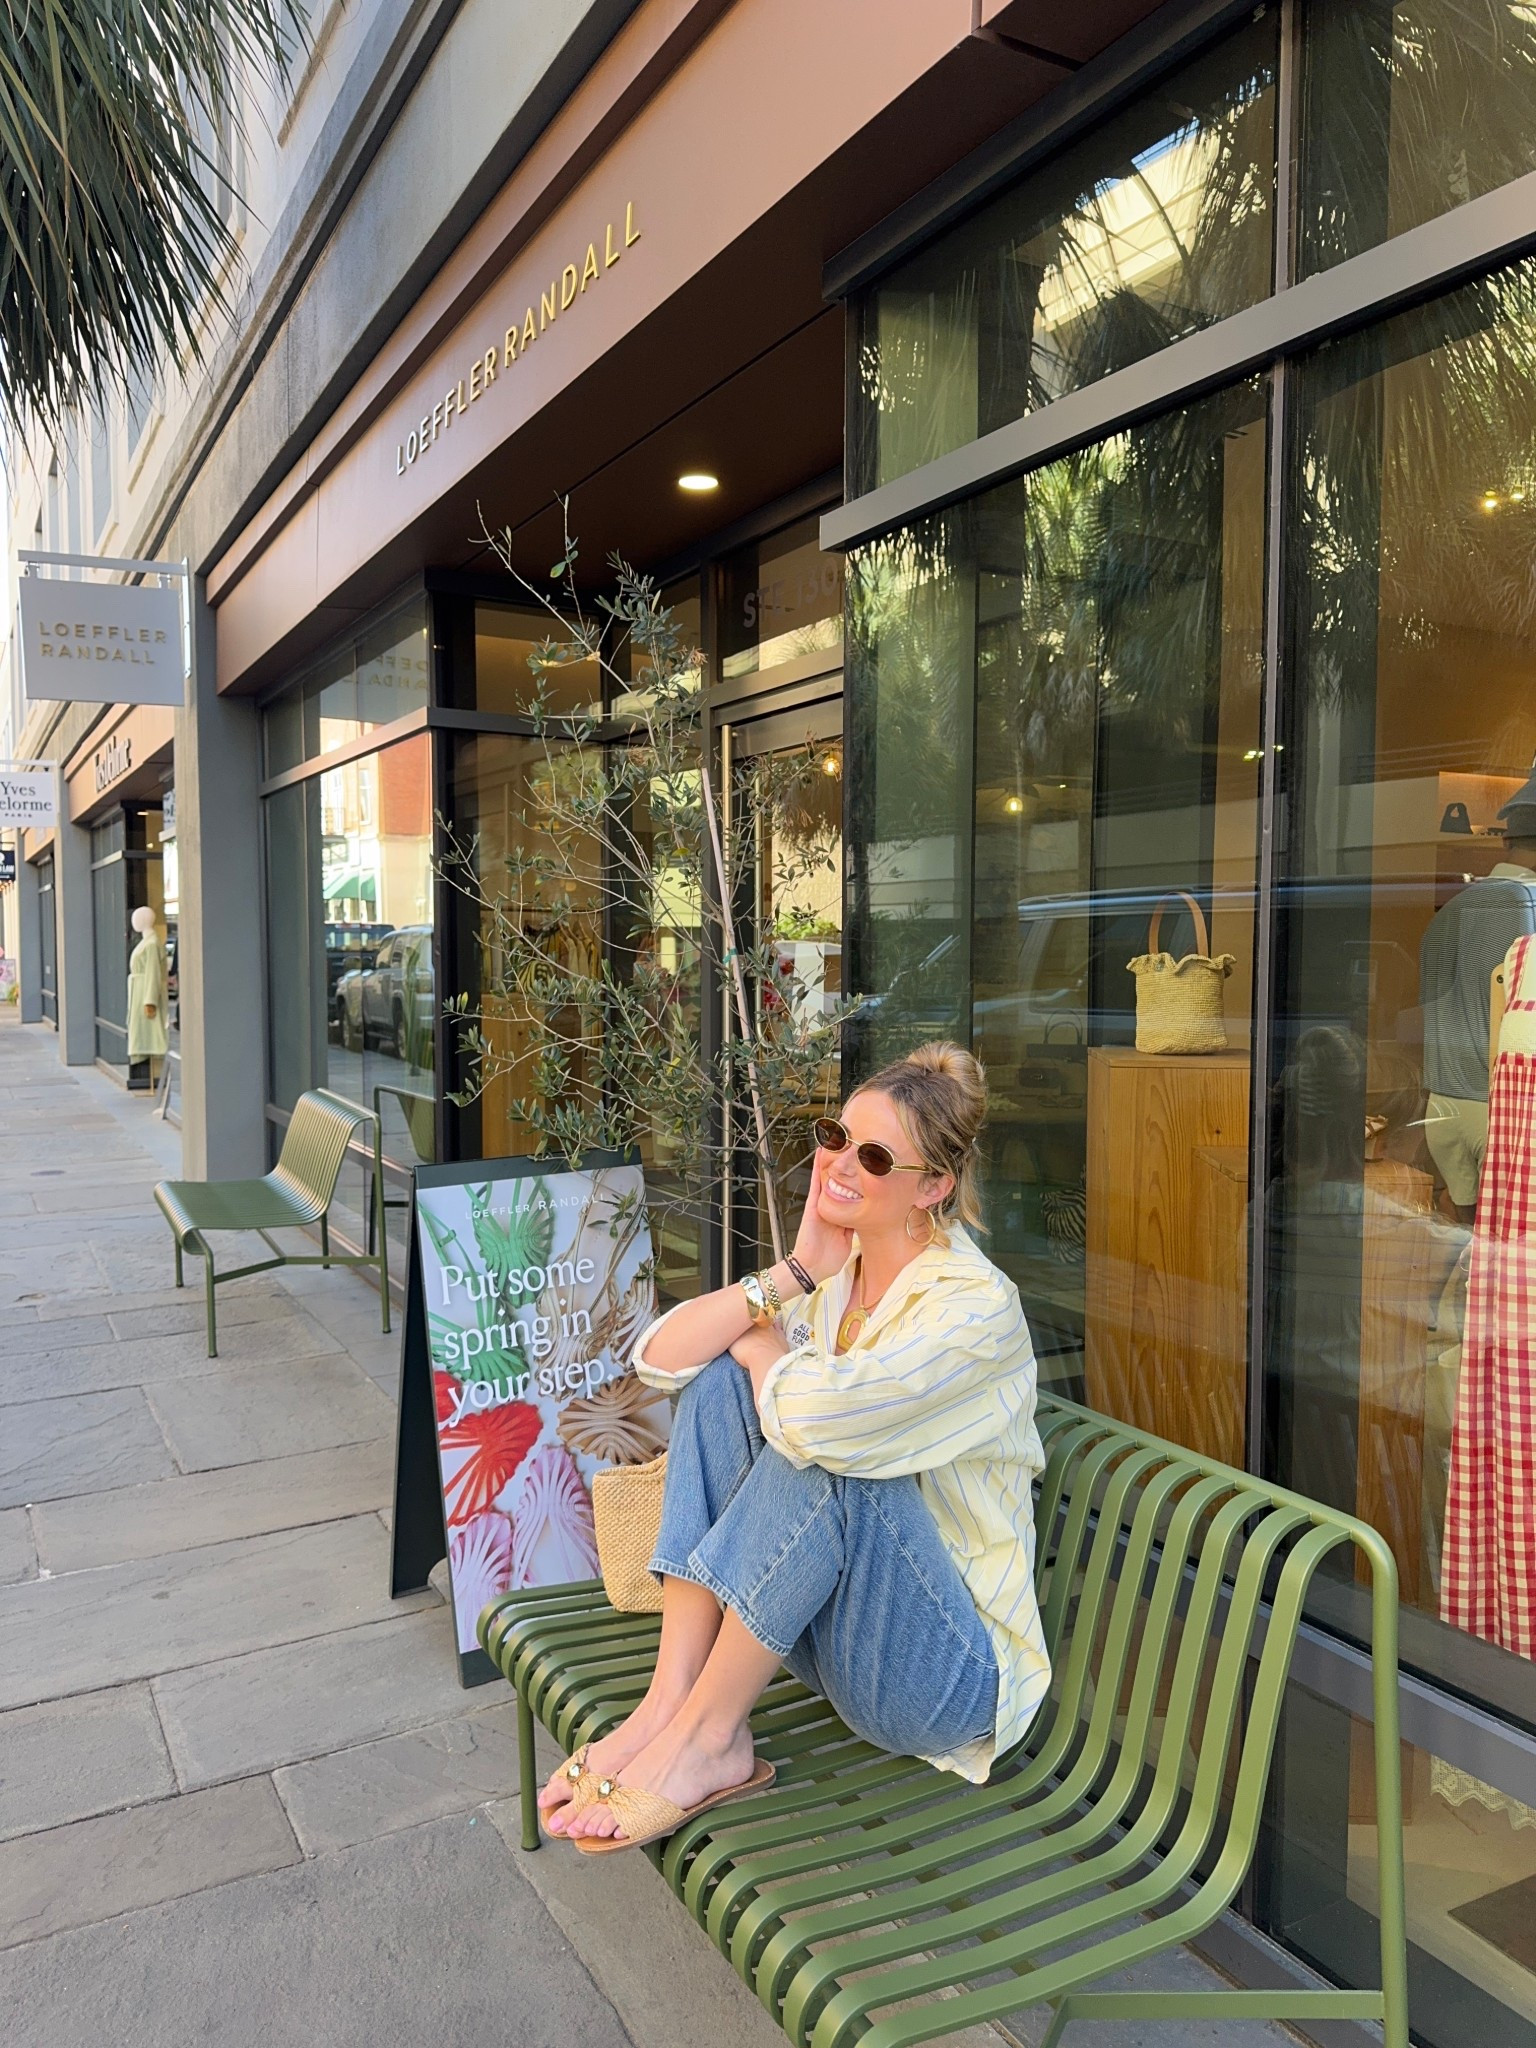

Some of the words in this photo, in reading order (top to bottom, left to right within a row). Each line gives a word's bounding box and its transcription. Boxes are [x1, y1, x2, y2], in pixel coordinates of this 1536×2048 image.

[397, 347, 498, 476] LOEFFLER
[503, 201, 642, 368] RANDALL
[38, 621, 168, 644] LOEFFLER
[40, 643, 156, 665] RANDALL
[0, 781, 36, 797] Yves
[0, 796, 53, 812] elorme
[465, 1204, 530, 1220] LOEFFLER
[440, 1265, 500, 1306] Put
[507, 1256, 595, 1296] some
[443, 1308, 552, 1371] spring
[560, 1298, 592, 1338] in
[793, 1328, 809, 1341] GOOD
[799, 1323, 809, 1334] ALL
[792, 1335, 804, 1346] FUN
[447, 1371, 531, 1427] your
[539, 1357, 615, 1400] step.
